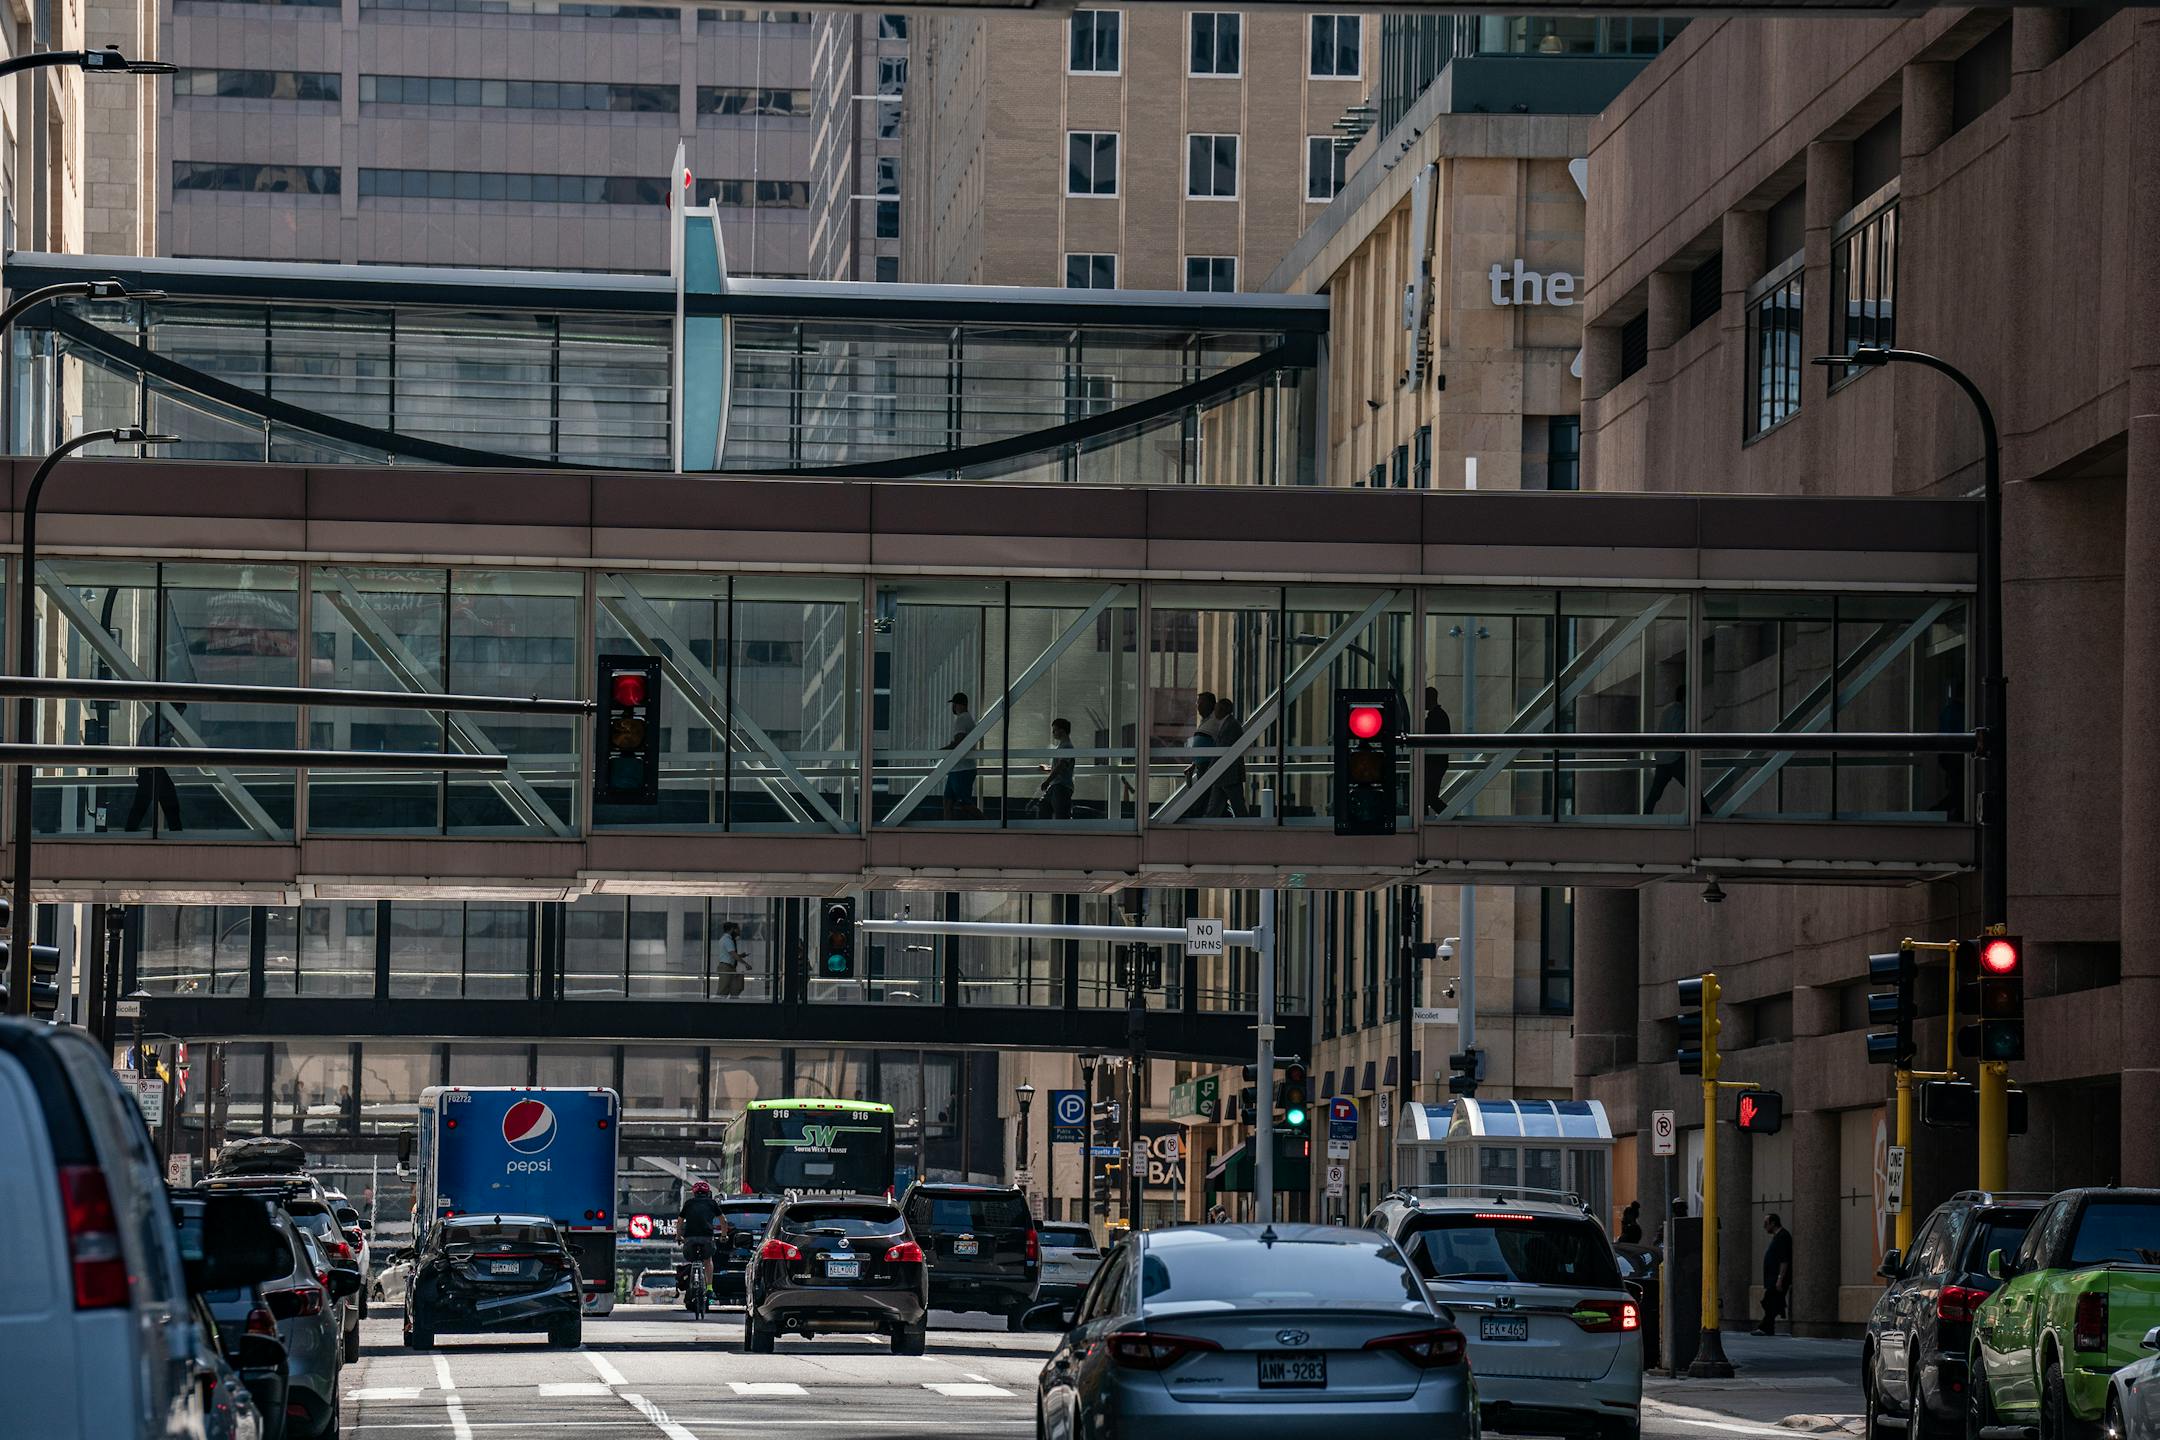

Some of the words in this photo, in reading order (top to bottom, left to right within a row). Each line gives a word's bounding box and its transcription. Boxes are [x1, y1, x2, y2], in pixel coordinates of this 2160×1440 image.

[1489, 258, 1575, 306] the
[1197, 925, 1213, 936] NO
[1188, 940, 1222, 950] TURNS
[1414, 1010, 1440, 1020] Nicollet
[773, 1110, 790, 1119] 916
[852, 1111, 869, 1120] 916
[1890, 1152, 1903, 1167] ONE
[507, 1158, 551, 1174] pepsi
[1889, 1171, 1902, 1186] WAY
